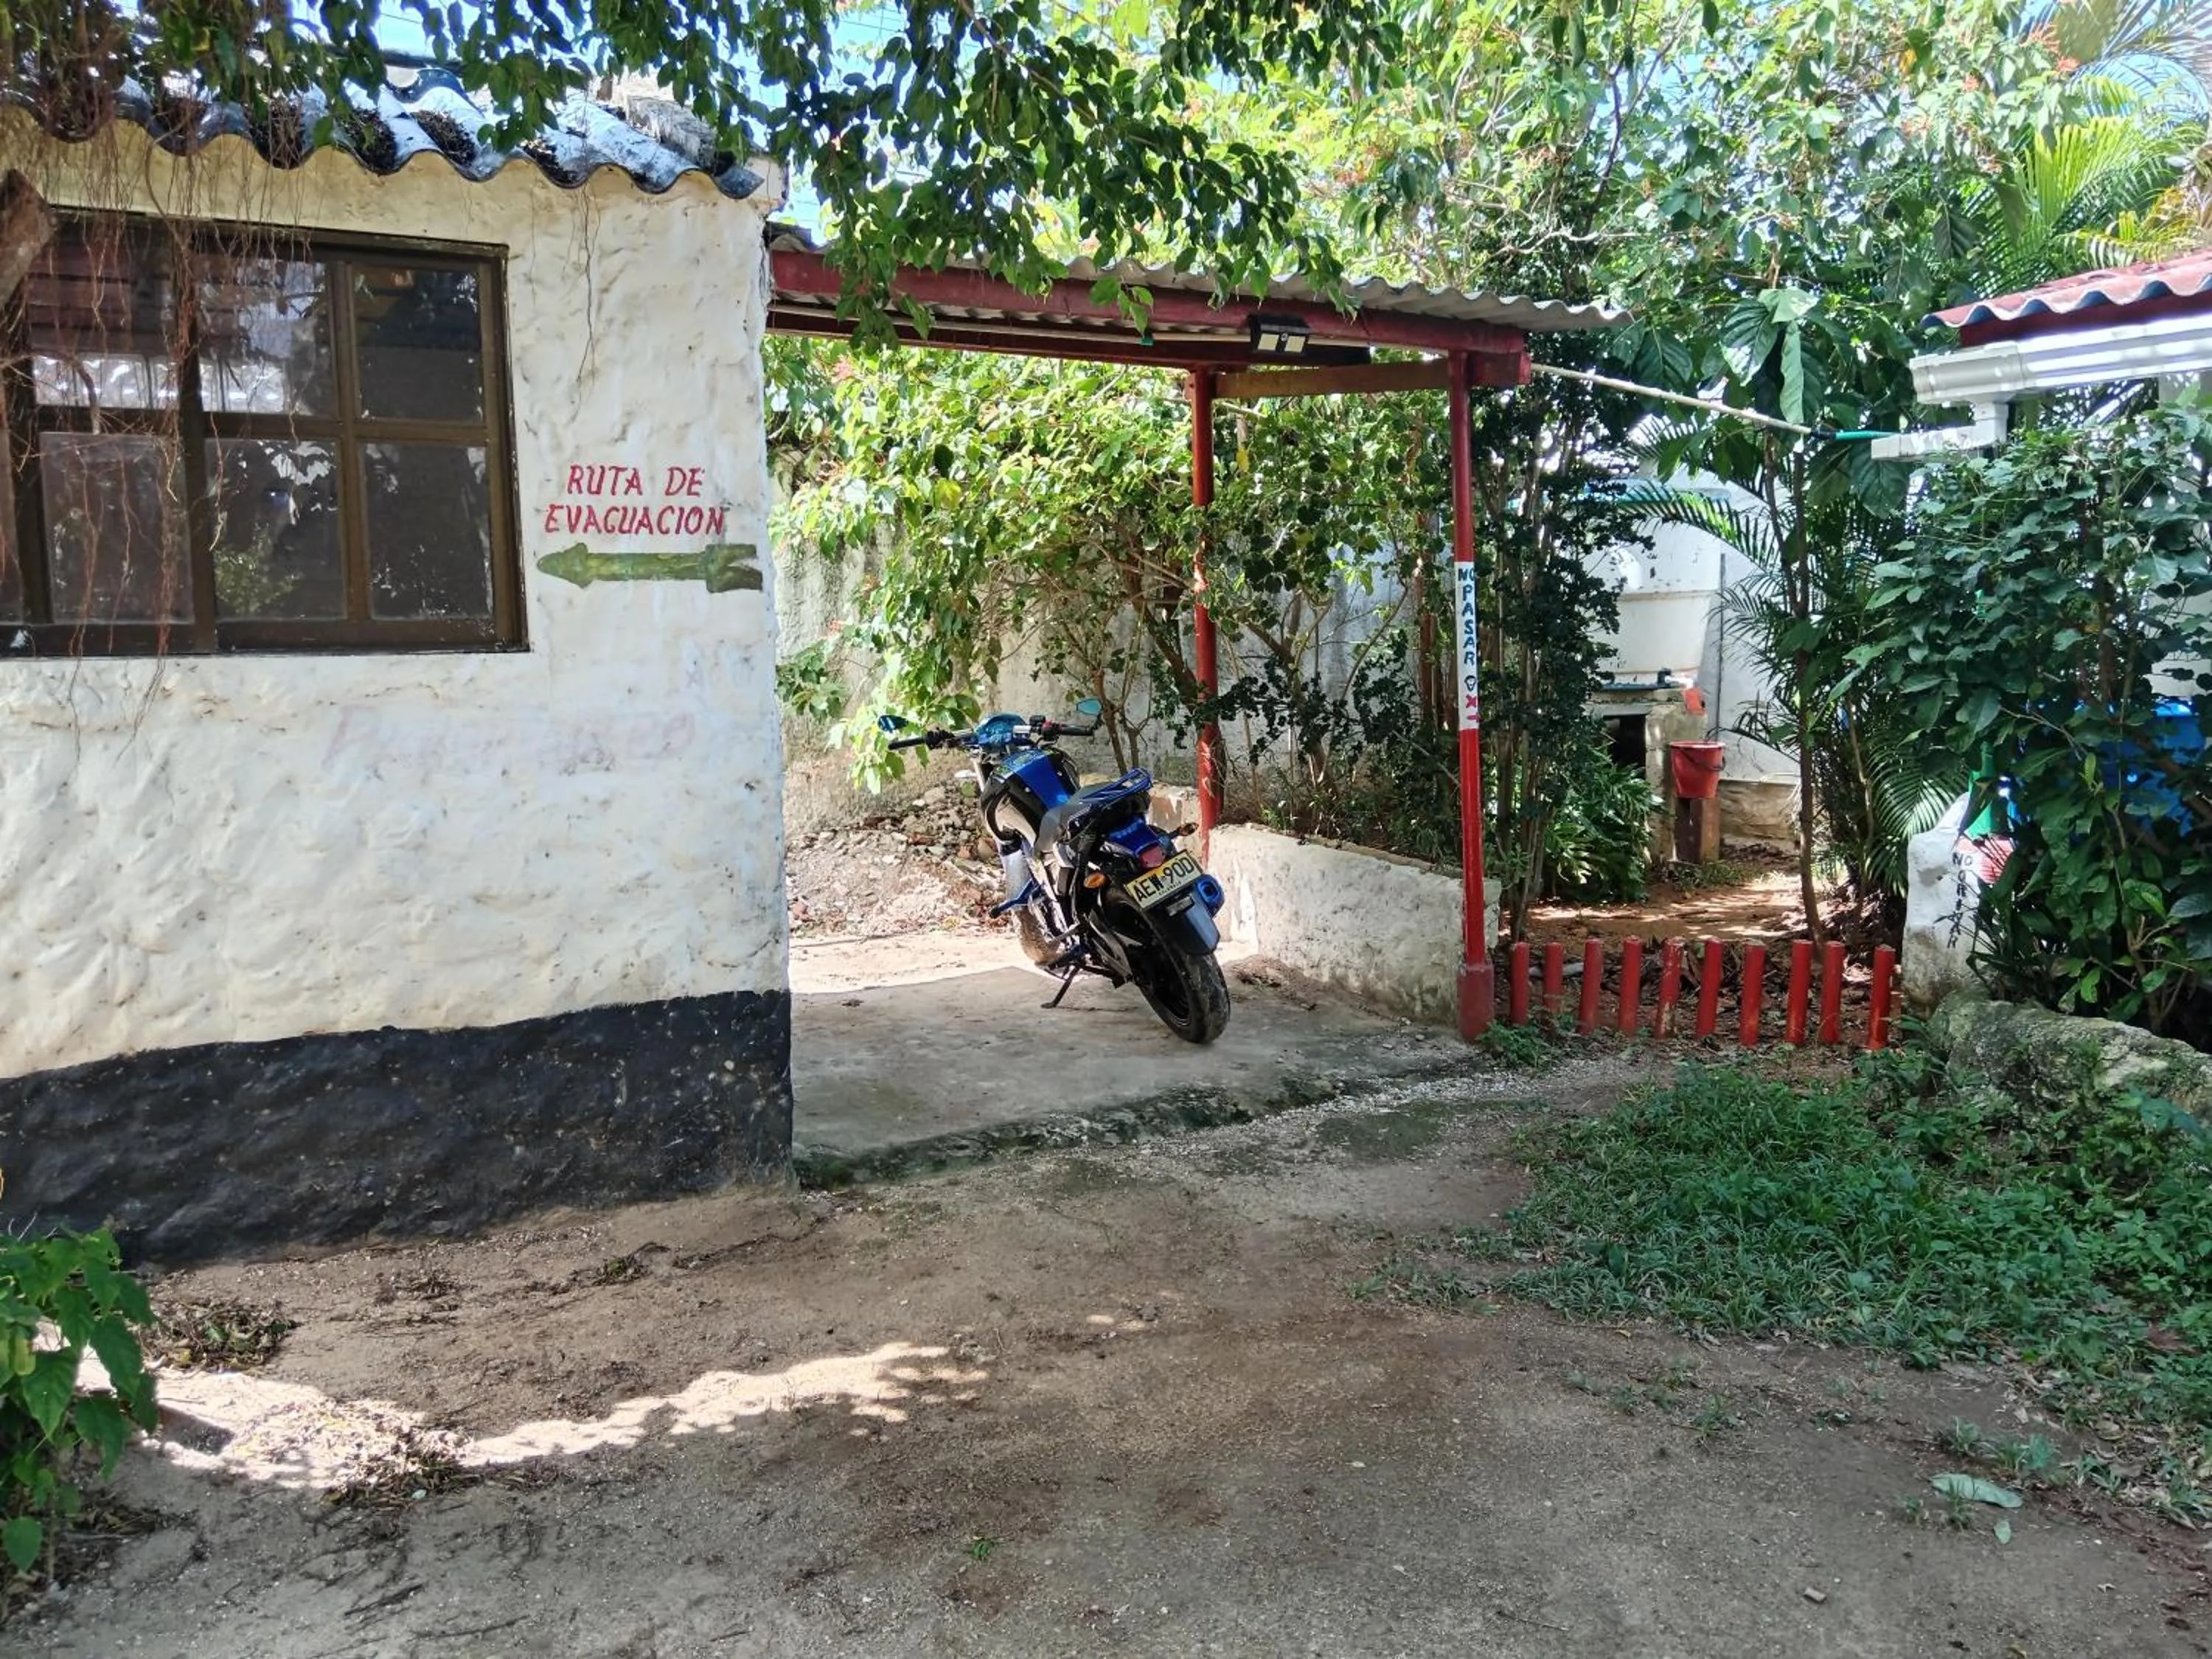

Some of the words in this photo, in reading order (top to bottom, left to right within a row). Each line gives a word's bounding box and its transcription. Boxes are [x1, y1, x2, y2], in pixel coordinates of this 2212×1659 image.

[567, 465, 643, 496] RUTA
[665, 466, 706, 497] DE
[544, 504, 726, 535] EVACUACION
[1458, 568, 1475, 582] NO
[1461, 585, 1475, 665] PASAR
[1952, 852, 1973, 866] NO
